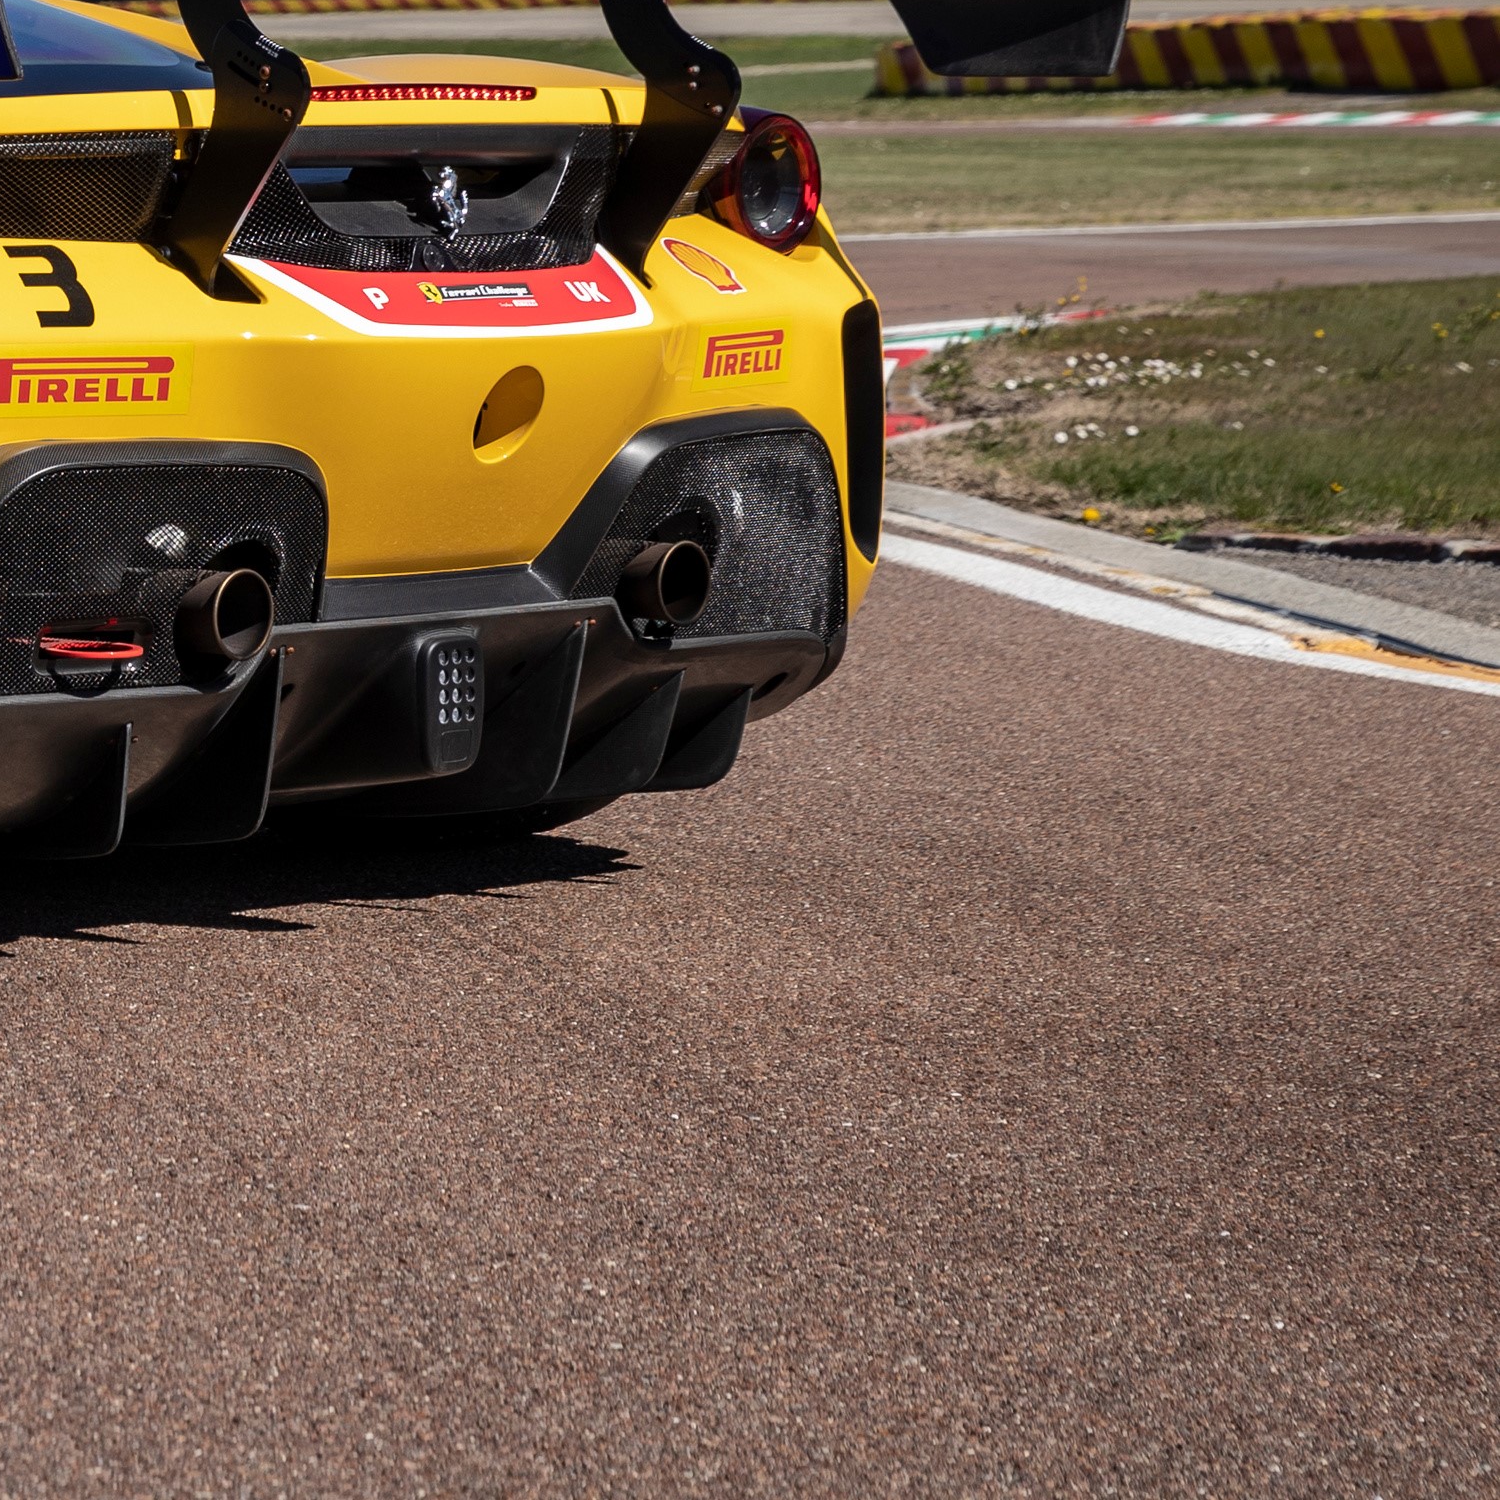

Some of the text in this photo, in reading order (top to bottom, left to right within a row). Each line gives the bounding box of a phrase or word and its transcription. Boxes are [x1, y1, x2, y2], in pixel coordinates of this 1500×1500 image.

[2, 245, 95, 328] 3
[441, 285, 529, 298] Ferrari Challenge
[564, 281, 611, 303] UK
[362, 287, 390, 310] P
[703, 329, 785, 379] PIRELLI
